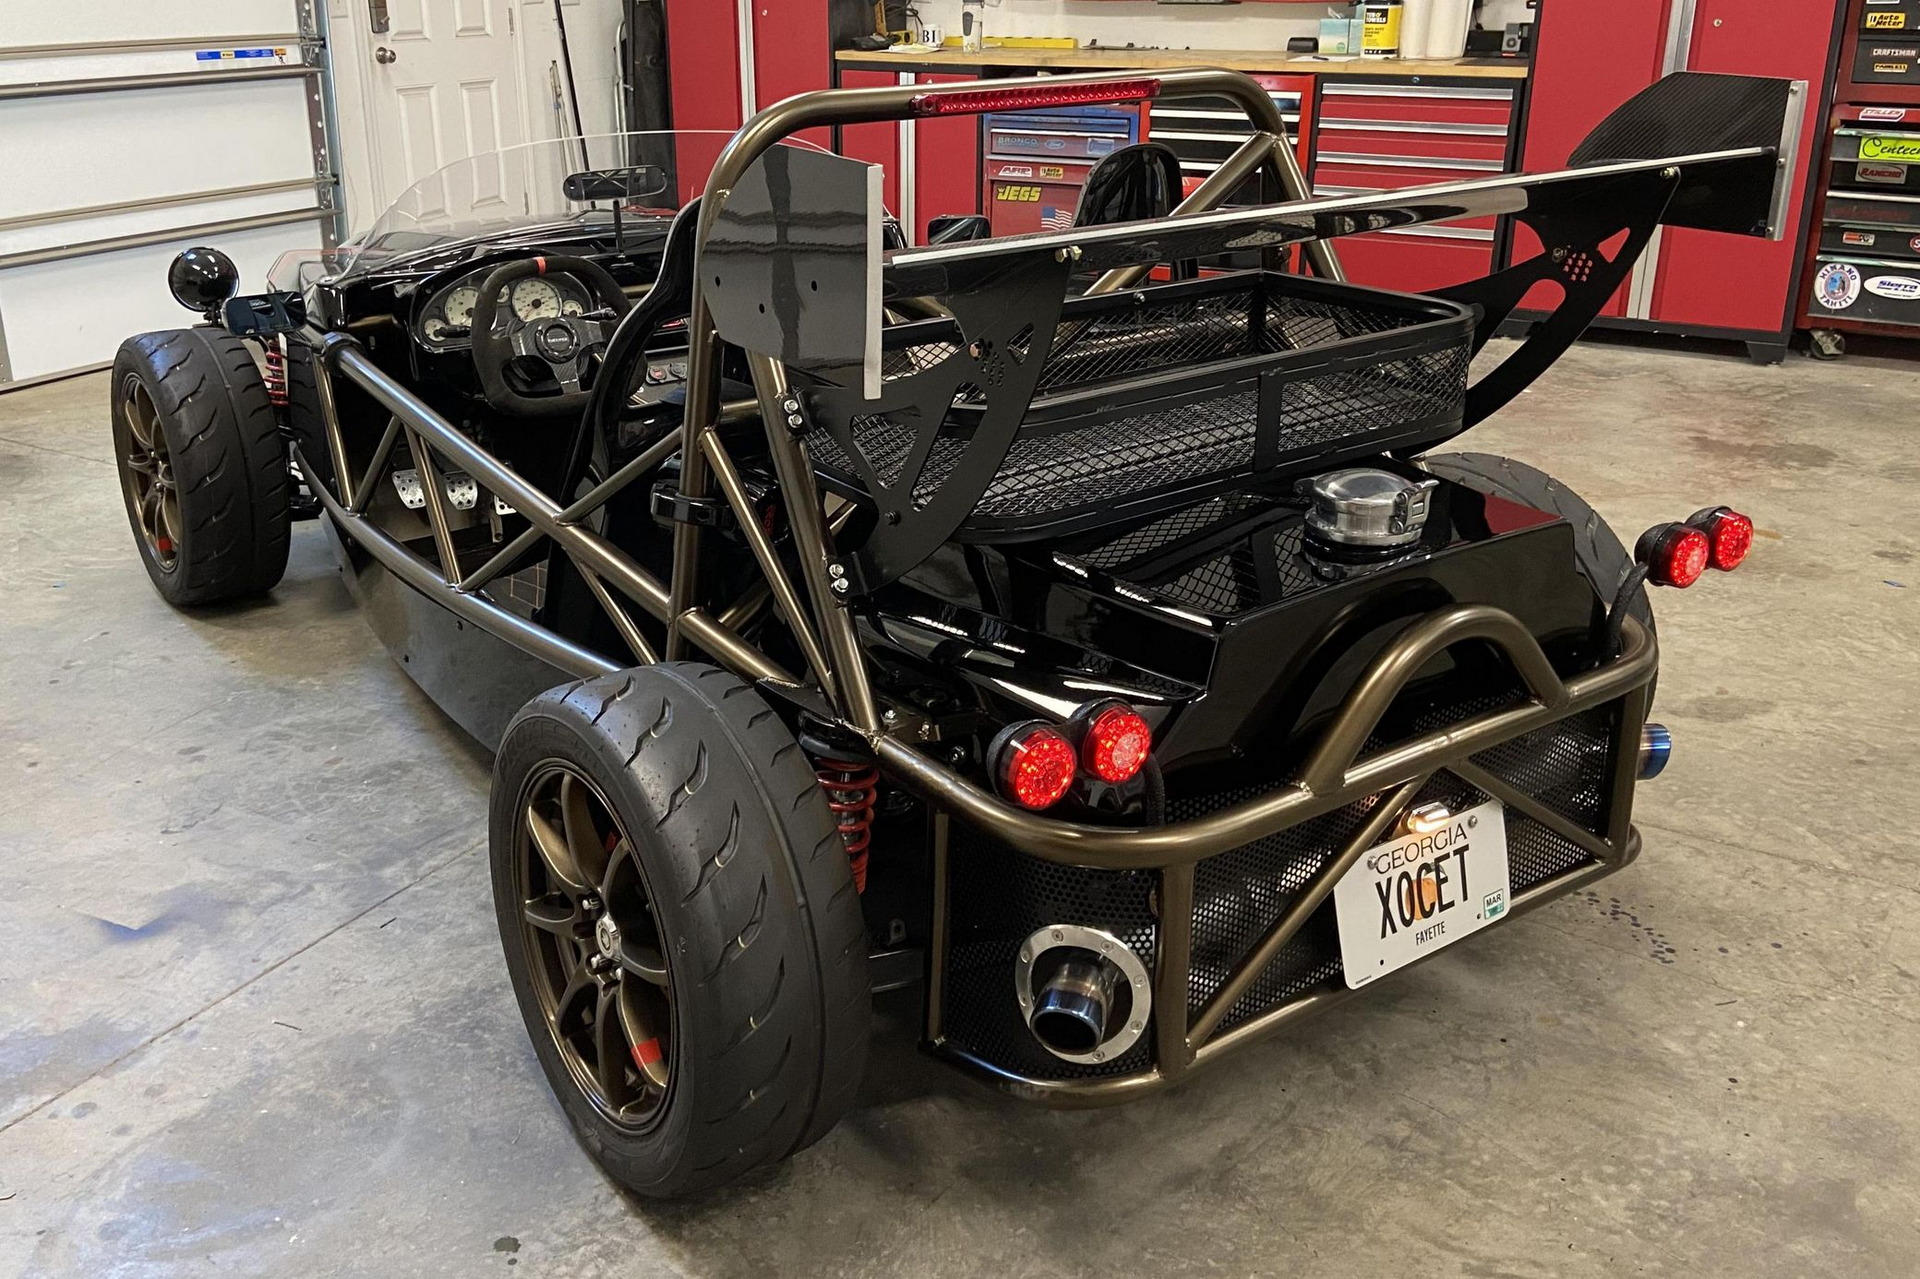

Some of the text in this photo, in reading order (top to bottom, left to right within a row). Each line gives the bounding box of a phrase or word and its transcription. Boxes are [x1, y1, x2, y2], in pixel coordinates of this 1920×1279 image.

[1873, 48, 1917, 57] CRAFTSMAN
[997, 136, 1038, 145] BRONCO
[1861, 167, 1902, 179] RANCHO
[997, 186, 1042, 202] JEGS
[1820, 264, 1857, 282] HINANO
[1878, 280, 1918, 290] Sierra
[1820, 294, 1853, 307] TAHITI
[1376, 822, 1468, 874] GEORGIA
[1374, 843, 1470, 940] XOCET
[1486, 893, 1502, 907] MAR
[1415, 920, 1446, 946] FAYETTE
